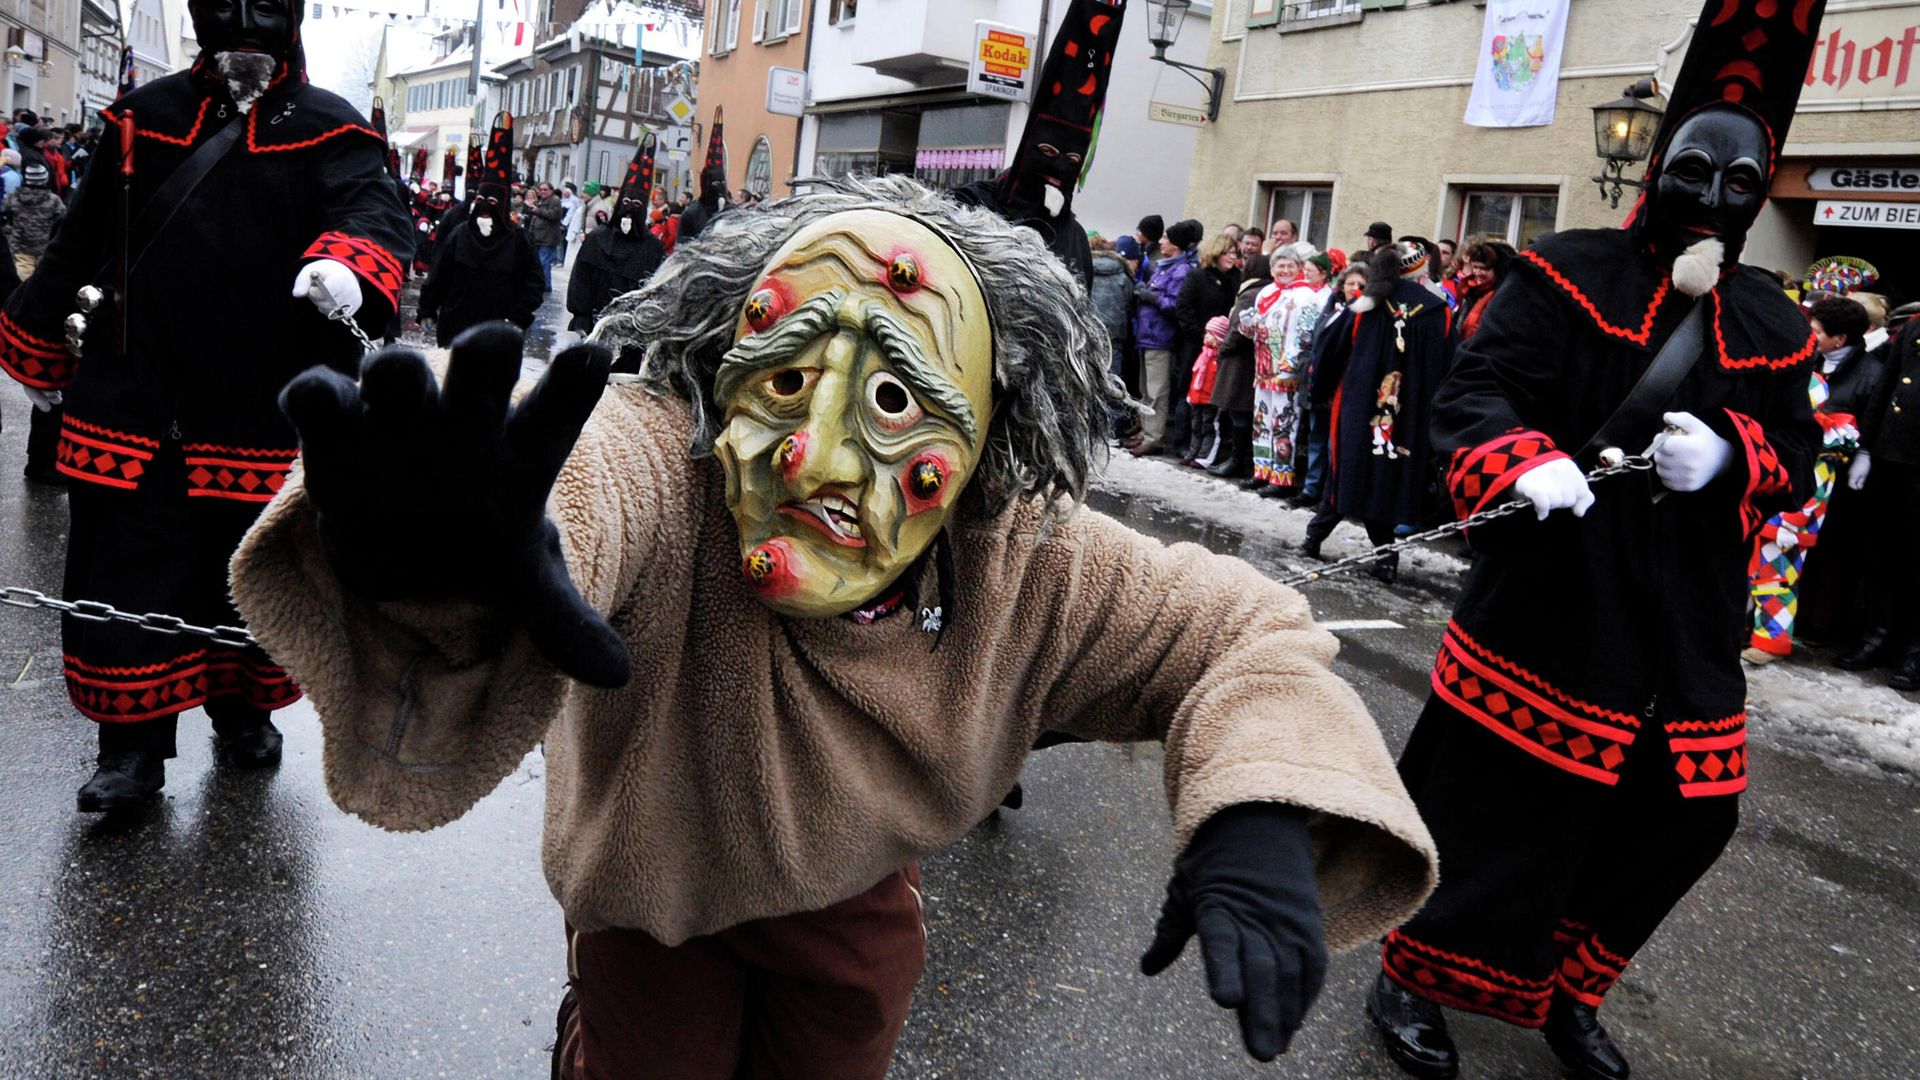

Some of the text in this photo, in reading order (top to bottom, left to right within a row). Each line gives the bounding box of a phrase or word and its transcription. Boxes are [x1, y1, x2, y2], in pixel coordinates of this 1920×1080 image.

[982, 44, 1027, 65] Kodak
[1161, 108, 1200, 121] Biergarten
[1830, 169, 1920, 189] Gäste
[1840, 206, 1920, 223] ZUM BIE
